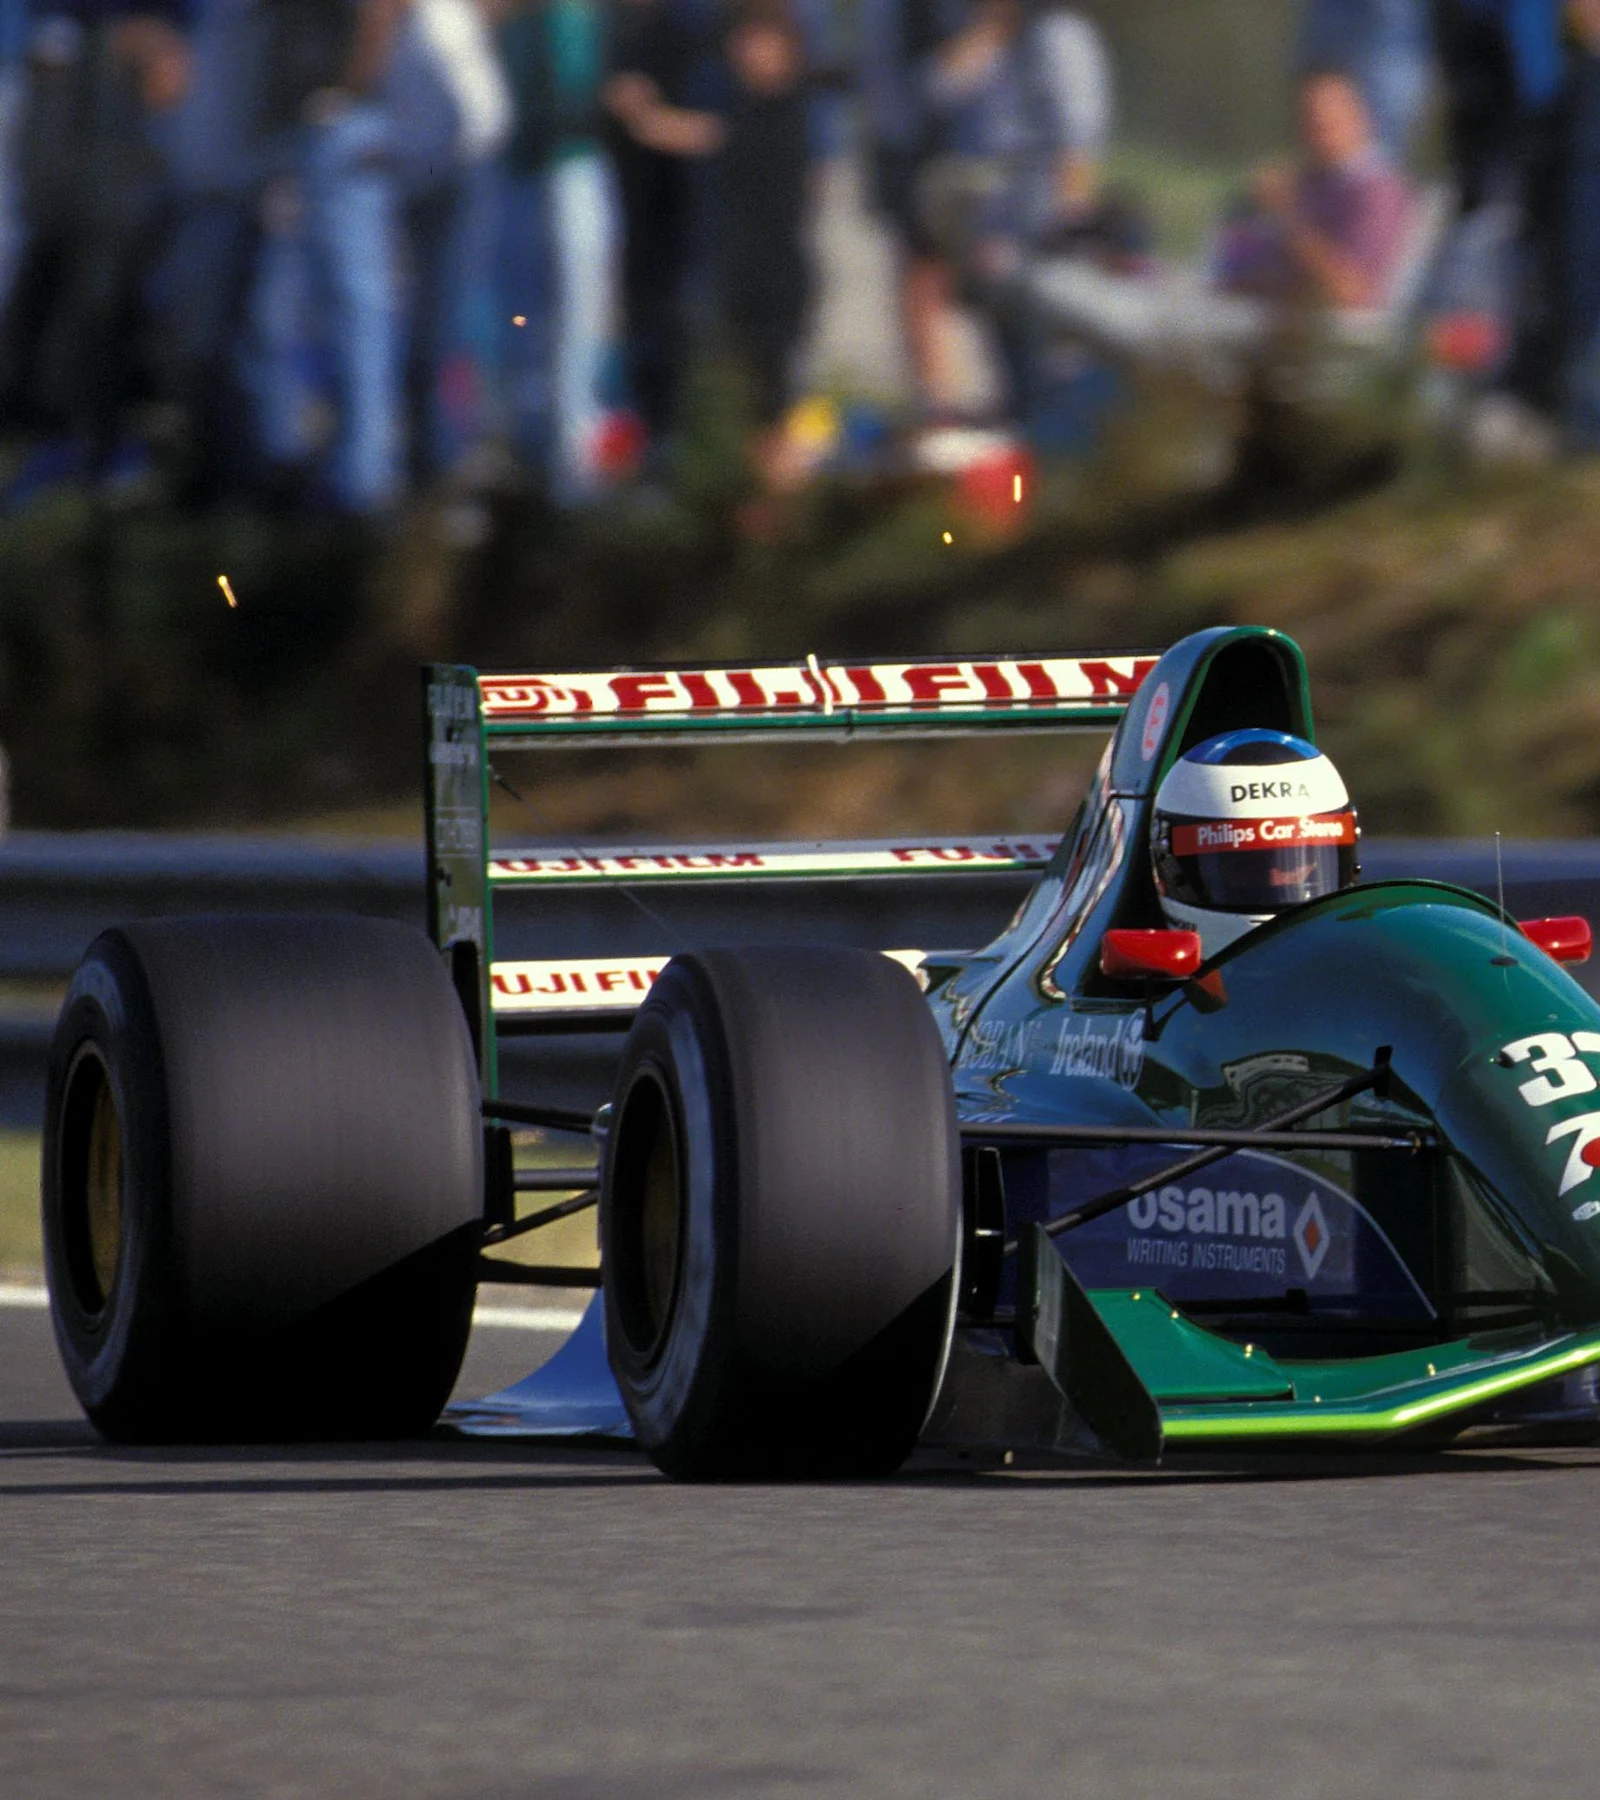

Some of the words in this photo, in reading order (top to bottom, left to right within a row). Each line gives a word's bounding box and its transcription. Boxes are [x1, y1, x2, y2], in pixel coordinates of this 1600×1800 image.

[1231, 781, 1311, 803] DEKRA
[1197, 824, 1256, 848] Philips
[1259, 821, 1295, 841] Car
[1049, 1017, 1125, 1078] Ireland
[1127, 1237, 1189, 1268] WRITING
[1192, 1242, 1287, 1277] INSTRUMENTS
